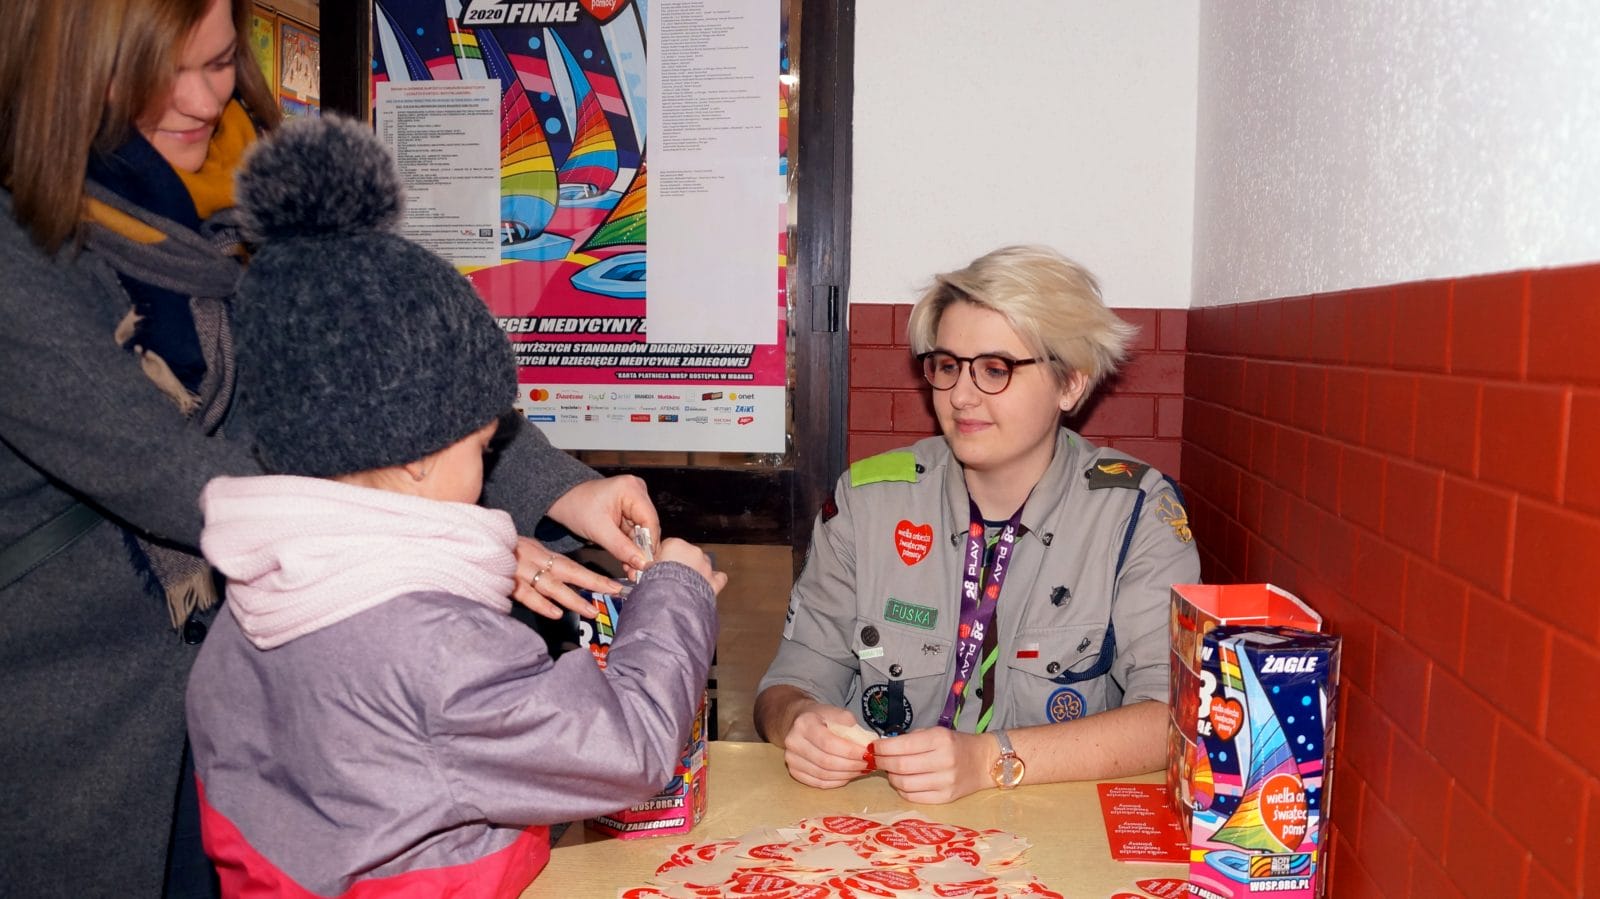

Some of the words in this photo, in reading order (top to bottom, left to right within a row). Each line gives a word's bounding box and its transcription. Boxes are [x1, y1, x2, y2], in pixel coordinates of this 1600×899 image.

[469, 9, 501, 20] 2020
[507, 2, 580, 23] FINAŁ
[538, 318, 637, 332] MEDYCYNY
[573, 341, 648, 353] STANDARDÓW
[649, 344, 754, 354] DIAGNOSTYCZNYCH
[548, 356, 560, 365] W
[560, 356, 618, 366] DZIECIĘCEJ
[619, 356, 680, 366] MEDYCYNIE
[681, 357, 750, 366] ZABIEGOWEJ
[1004, 525, 1014, 543] 28
[968, 540, 980, 576] PLAY
[994, 546, 1008, 582] PLAY
[964, 580, 976, 600] 28
[892, 604, 930, 625] FUSKA
[974, 620, 984, 640] 28
[961, 643, 976, 678] PLAY
[1260, 655, 1318, 673] ŻAGLE
[1266, 787, 1294, 804] wielka
[626, 818, 685, 831] ZABIEGOWEJ
[1250, 879, 1309, 892] WOSP.ORG.PL
